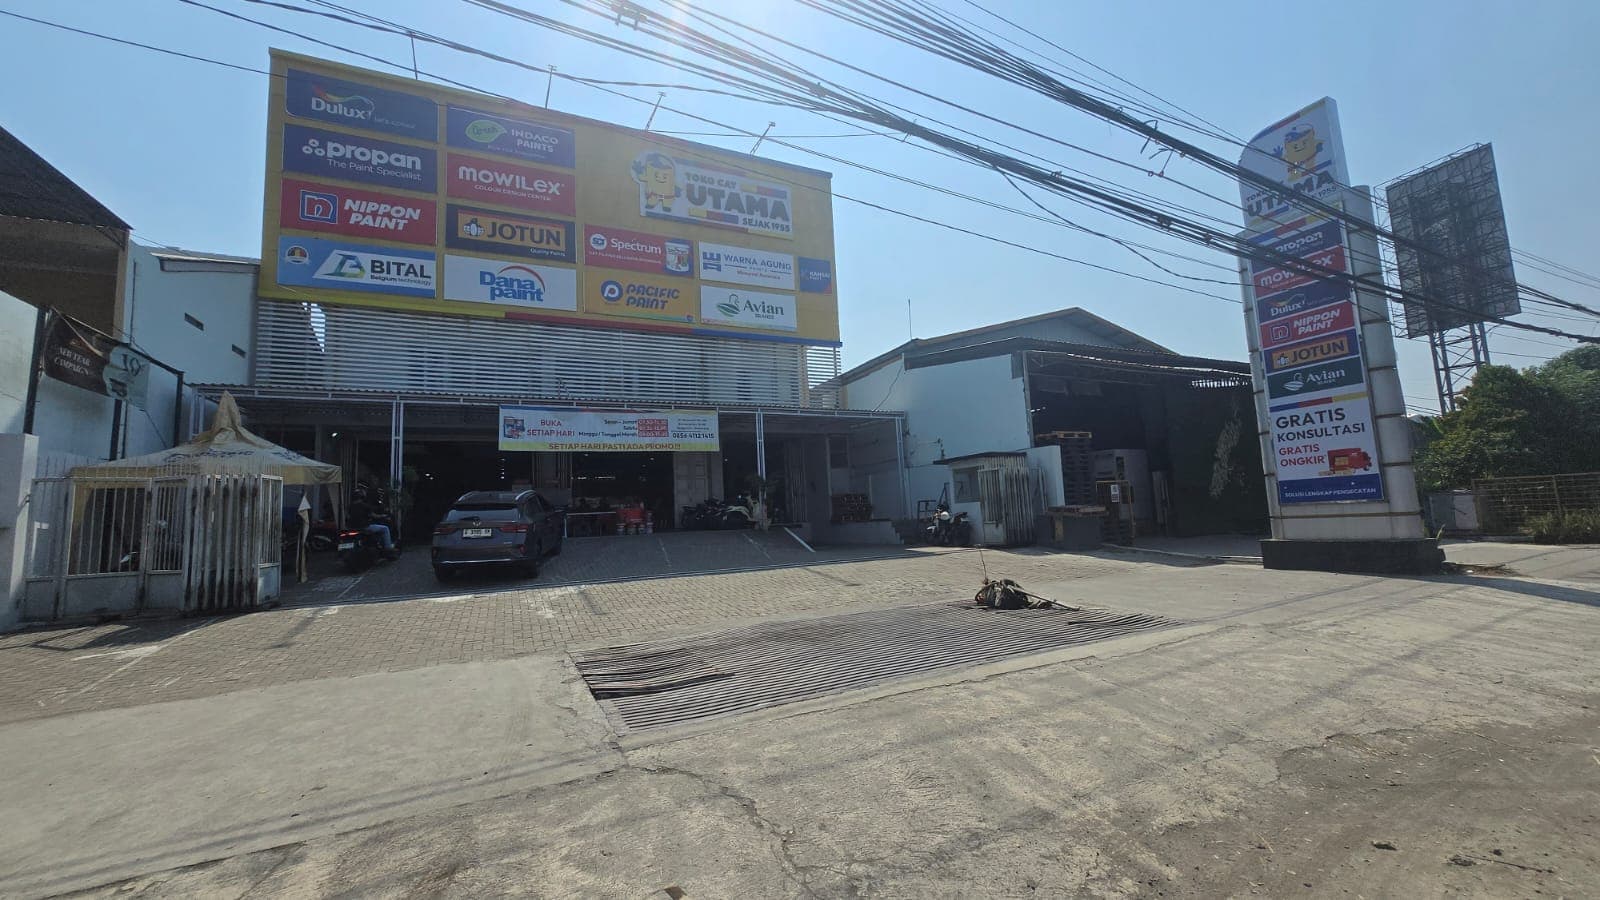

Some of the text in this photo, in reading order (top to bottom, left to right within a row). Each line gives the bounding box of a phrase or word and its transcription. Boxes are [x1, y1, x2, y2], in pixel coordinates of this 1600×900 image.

[311, 96, 366, 120] Dulux
[511, 129, 560, 145] INDACO
[517, 139, 554, 153] PAINTS
[327, 141, 422, 170] propan
[328, 158, 422, 181] The Paint Specialist
[685, 172, 715, 188] TOKO
[345, 198, 421, 220] NIPPON
[685, 183, 790, 222] UTAMA
[350, 213, 408, 231] PAINT
[742, 217, 770, 230] SEJAK
[487, 221, 561, 247] JOTUN
[610, 238, 662, 255] Spectrum
[370, 259, 432, 279] BITAL
[723, 254, 792, 270] WARNA AGUNG
[370, 274, 397, 283] Belgium
[479, 270, 535, 290] Dana
[490, 284, 544, 301] paint
[626, 283, 680, 300] PACIFIC
[626, 296, 669, 310] PAINT
[743, 299, 785, 316] Avian
[1270, 302, 1301, 317] Dulux
[1293, 308, 1341, 328] NIPPON
[1298, 320, 1334, 336] PAINT
[1291, 339, 1345, 364] JOTUN
[1306, 367, 1346, 384] Avian
[540, 419, 562, 427] BUKA
[1275, 407, 1346, 429] GRATIS
[527, 429, 575, 437] SETIAP HARI
[1277, 422, 1366, 443] KONSULTASI
[1279, 443, 1320, 456] GRATIS
[1280, 455, 1325, 467] ONGKIR
